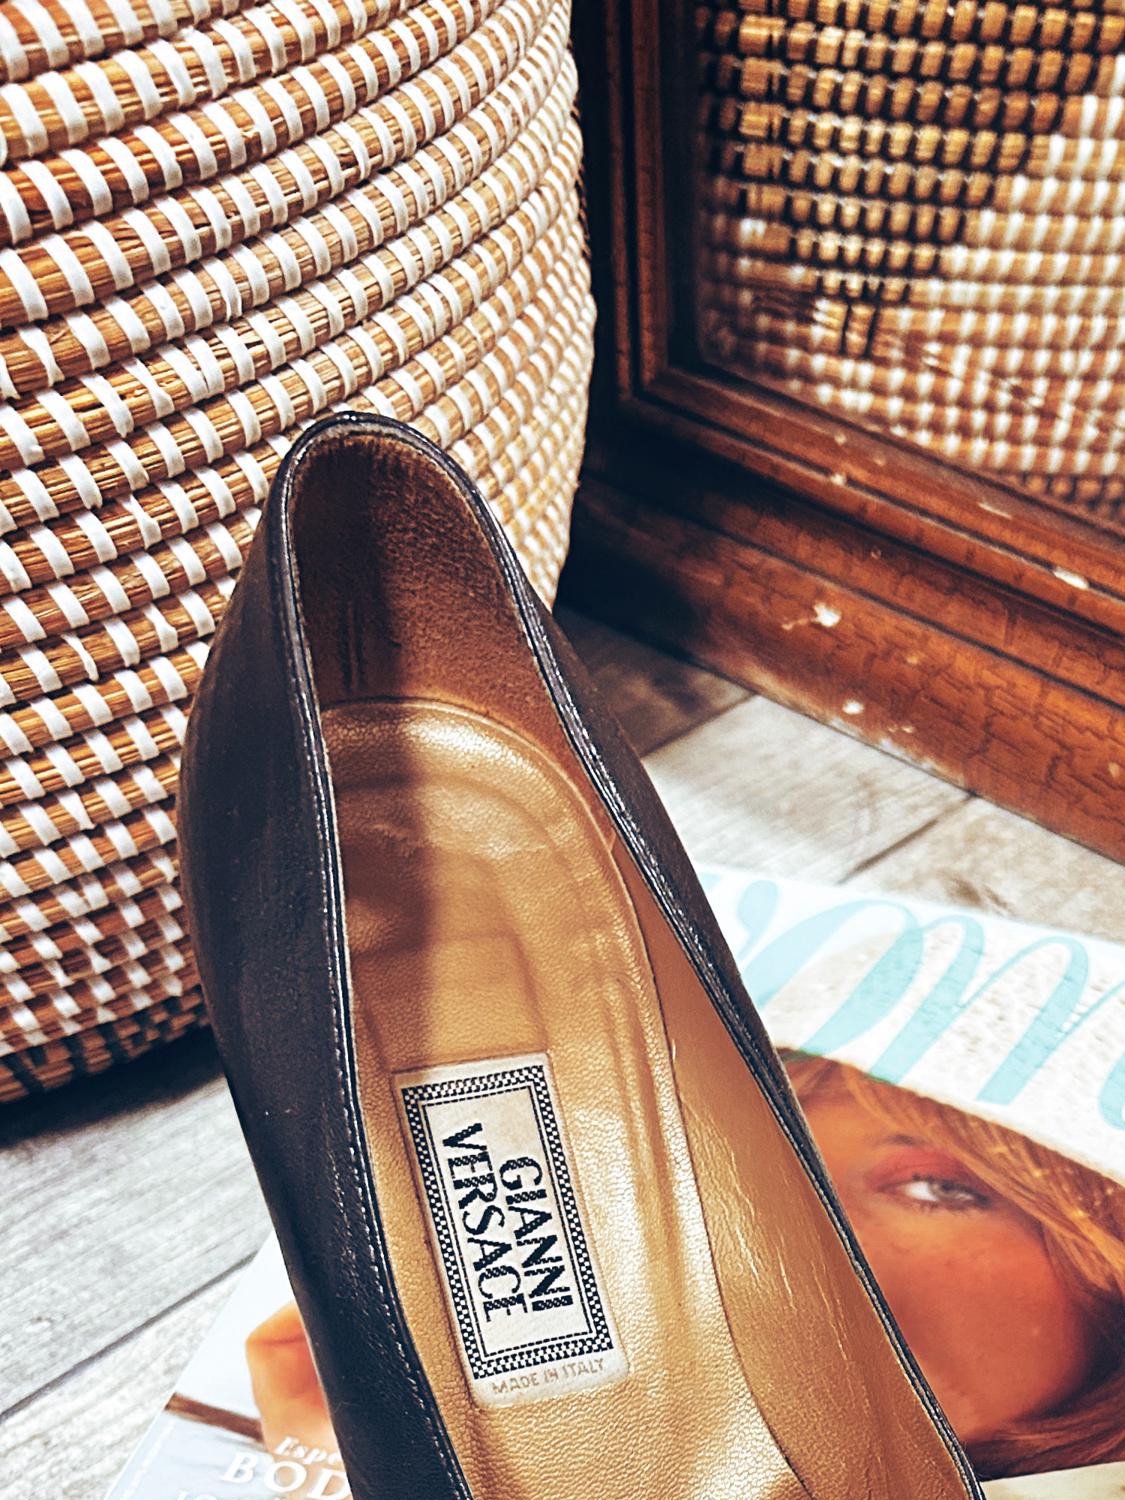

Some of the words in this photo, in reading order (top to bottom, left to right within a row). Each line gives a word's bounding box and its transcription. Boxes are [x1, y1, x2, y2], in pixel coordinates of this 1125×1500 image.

[442, 1123, 528, 1322] VERSACE
[500, 1157, 573, 1311] GIANNI
[491, 1372, 539, 1394] MADE
[563, 1358, 605, 1380] ITALY
